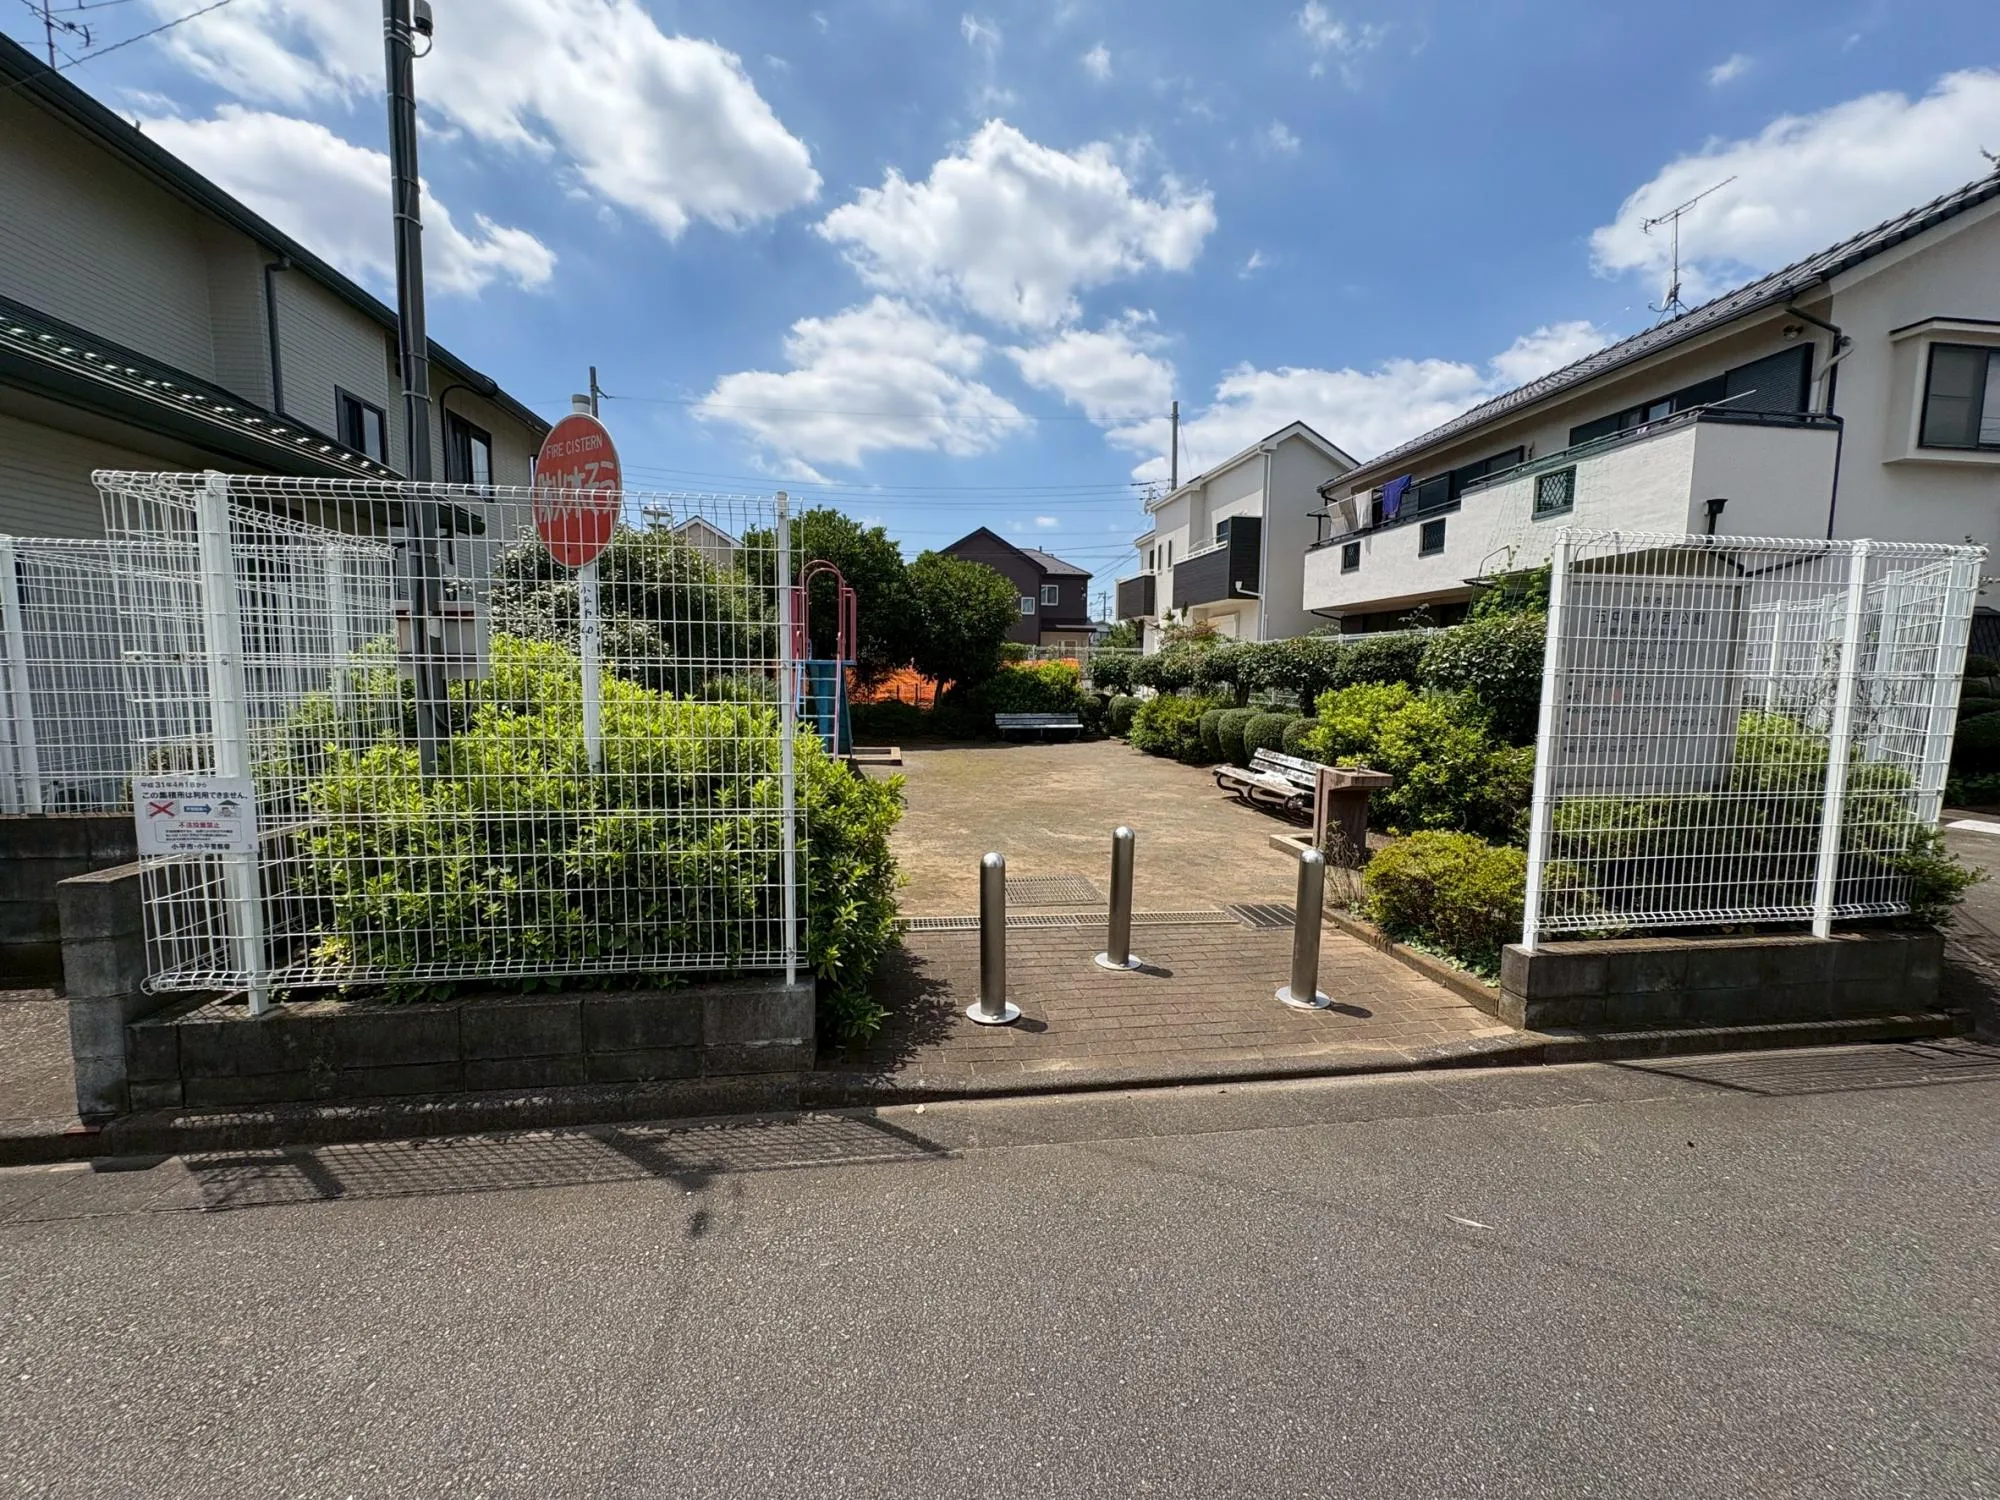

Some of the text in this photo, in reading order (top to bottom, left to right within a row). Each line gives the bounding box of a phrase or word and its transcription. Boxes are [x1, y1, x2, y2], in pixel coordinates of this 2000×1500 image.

[546, 434, 602, 459] FIRE CISTERN
[142, 791, 248, 800] この集積所は利用できません。
